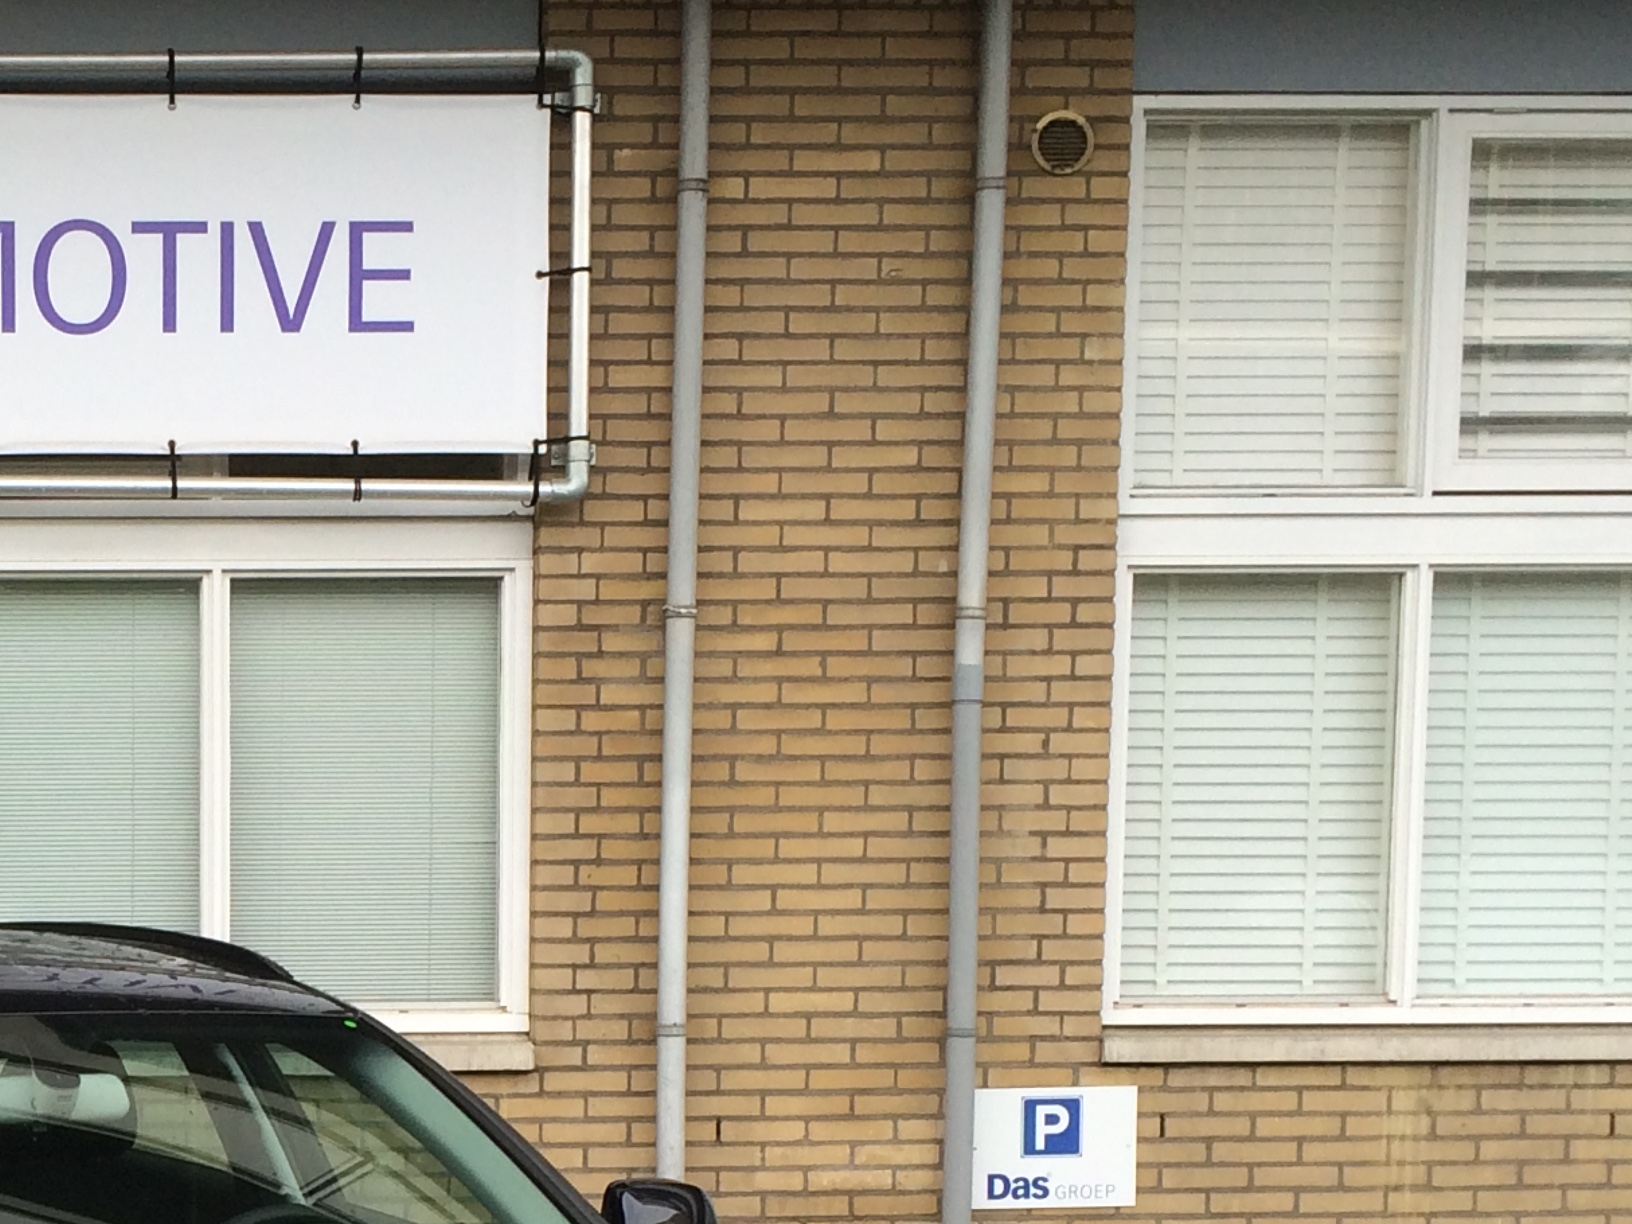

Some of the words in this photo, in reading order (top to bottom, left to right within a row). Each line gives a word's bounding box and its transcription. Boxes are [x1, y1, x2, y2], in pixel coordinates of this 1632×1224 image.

[1034, 1103, 1070, 1151] P
[986, 1172, 1050, 1201] Das
[1054, 1183, 1116, 1201] GROEP
